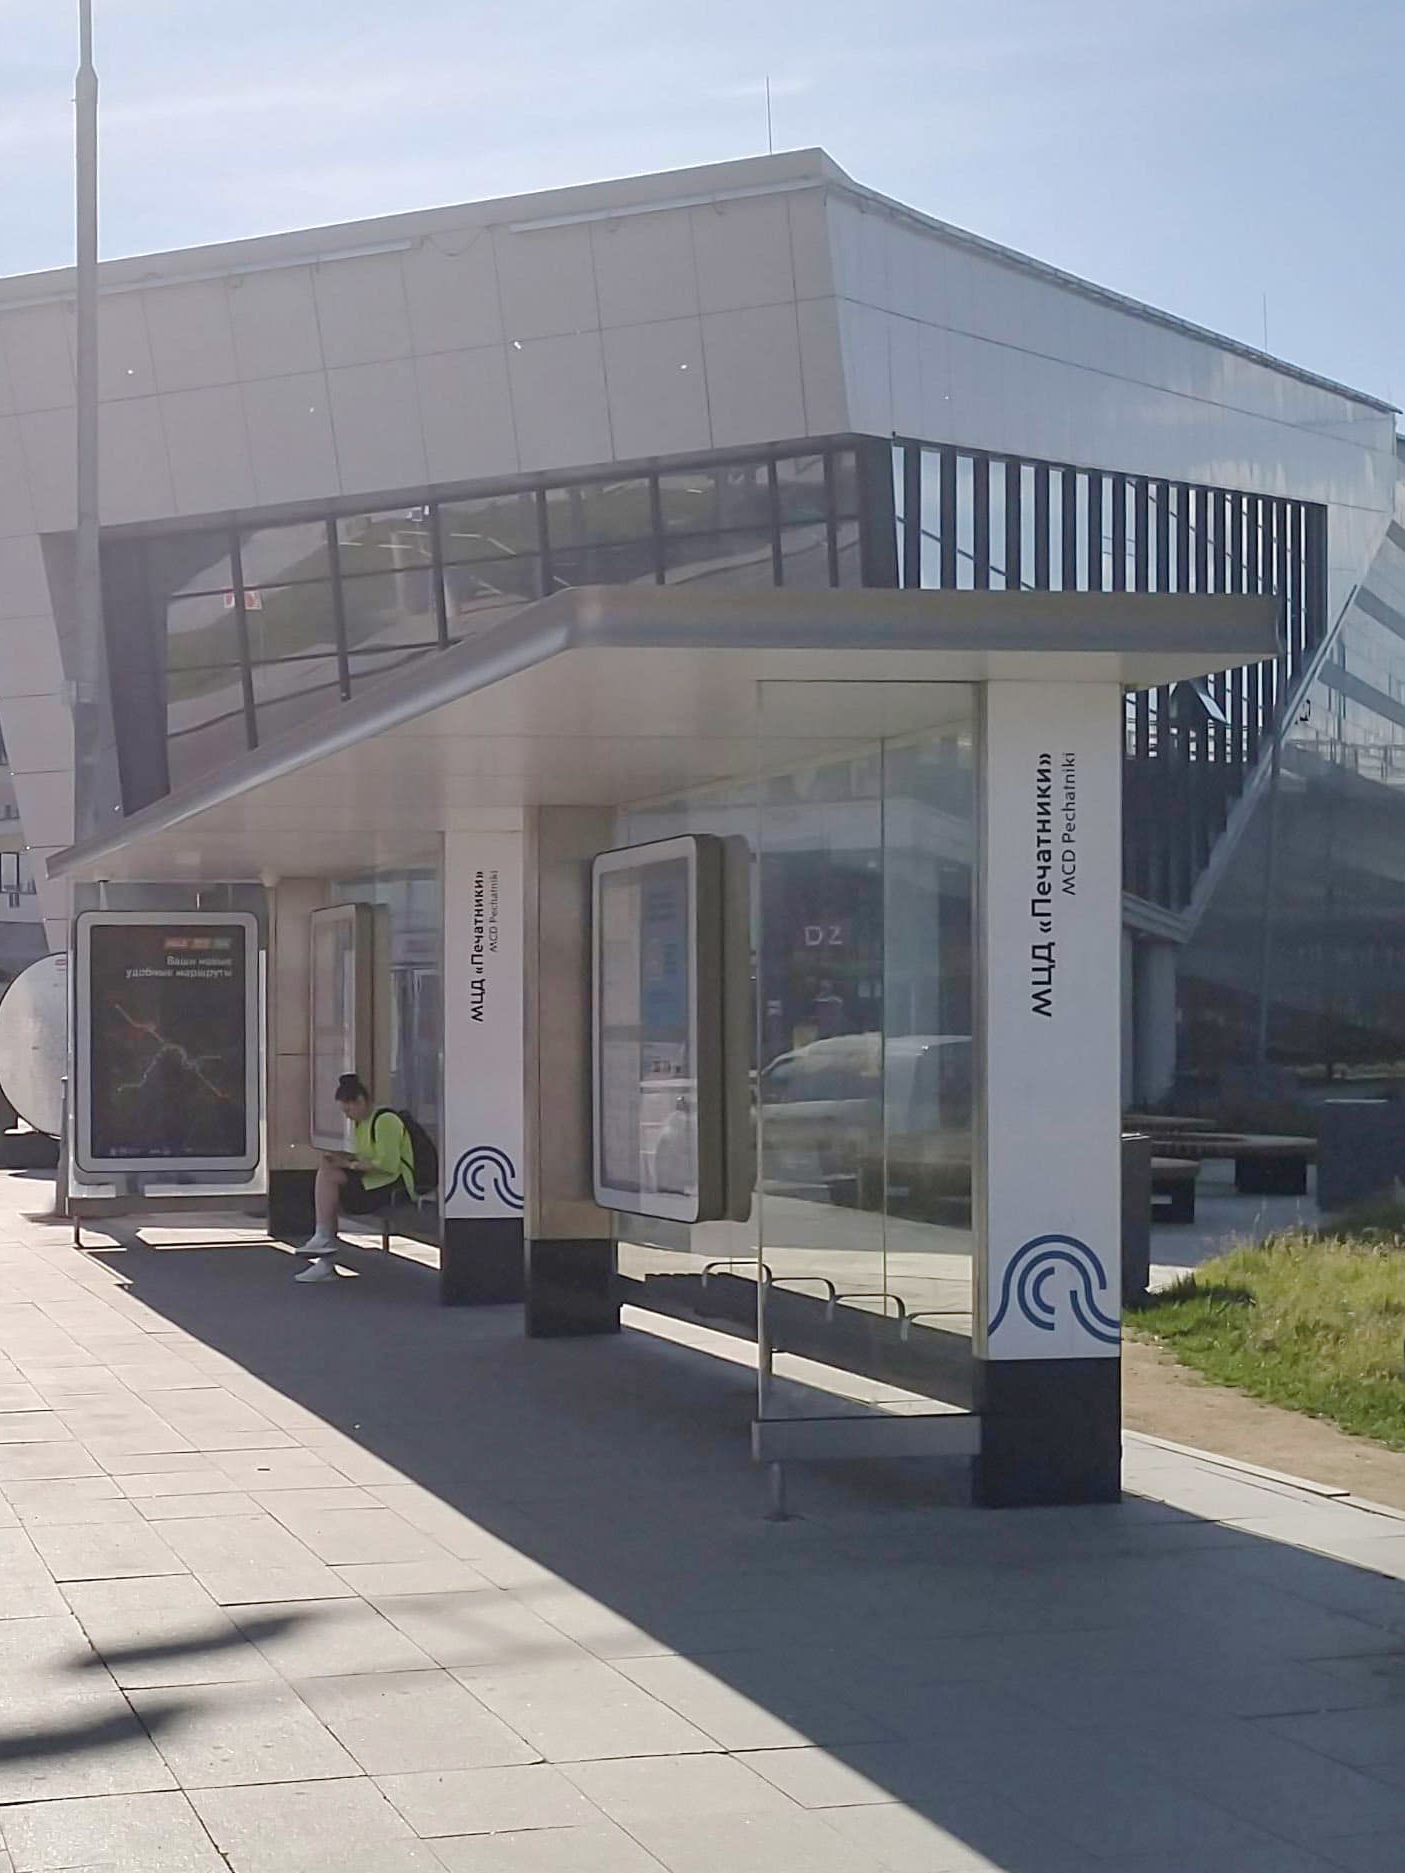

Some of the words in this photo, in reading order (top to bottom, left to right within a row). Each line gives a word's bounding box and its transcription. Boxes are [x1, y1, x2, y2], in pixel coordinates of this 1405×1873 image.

[1060, 751, 1077, 844] Pechatniki
[1030, 752, 1053, 934] «Печатники»
[1060, 849, 1077, 896] MCD
[470, 870, 485, 975] «Печатники»
[488, 925, 499, 953] MCD
[804, 925, 843, 946] D2
[470, 978, 486, 1022] МЦД
[1030, 941, 1056, 1018] МЦД
